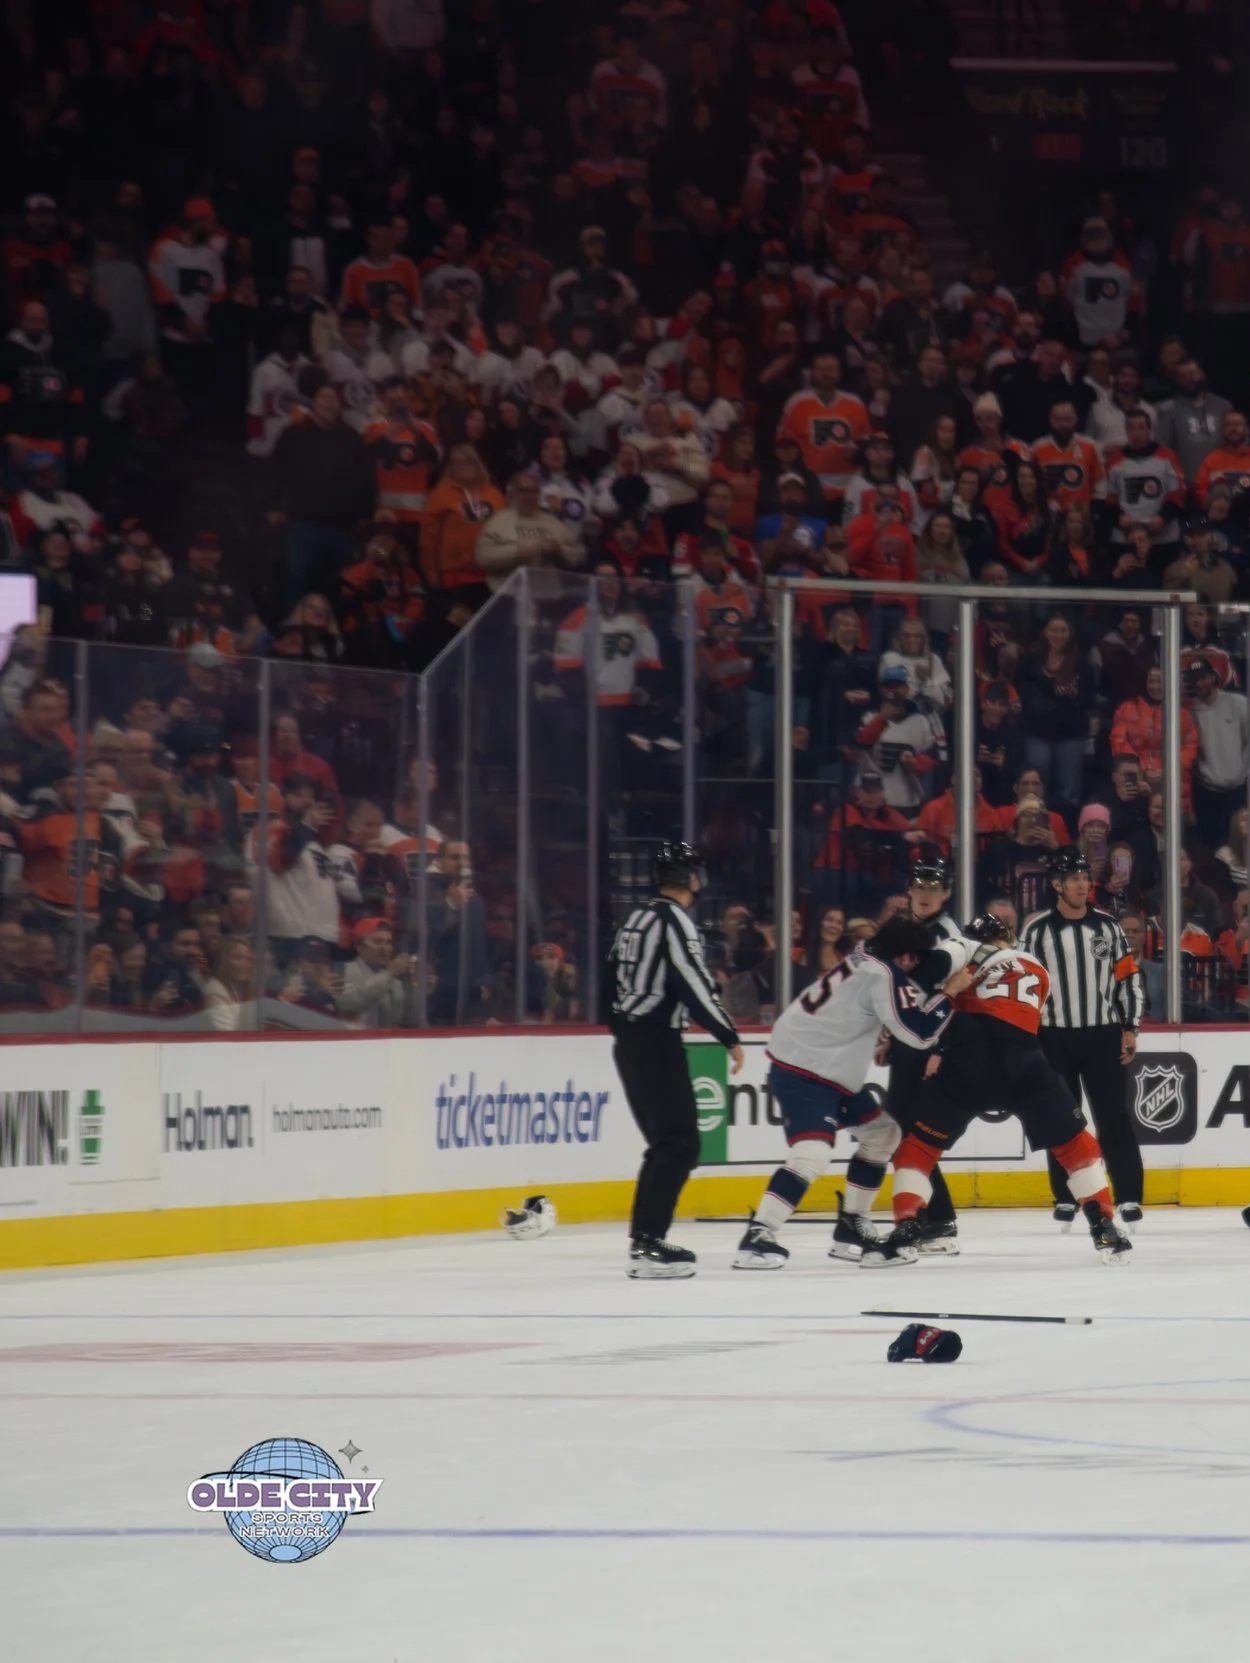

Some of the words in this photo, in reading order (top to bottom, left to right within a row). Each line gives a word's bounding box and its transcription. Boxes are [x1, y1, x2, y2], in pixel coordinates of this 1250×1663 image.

[975, 968, 1041, 1010] 22
[273, 1104, 382, 1133] holmanauto.com
[435, 1071, 609, 1150] ticketmaster
[1145, 1082, 1175, 1117] NHL
